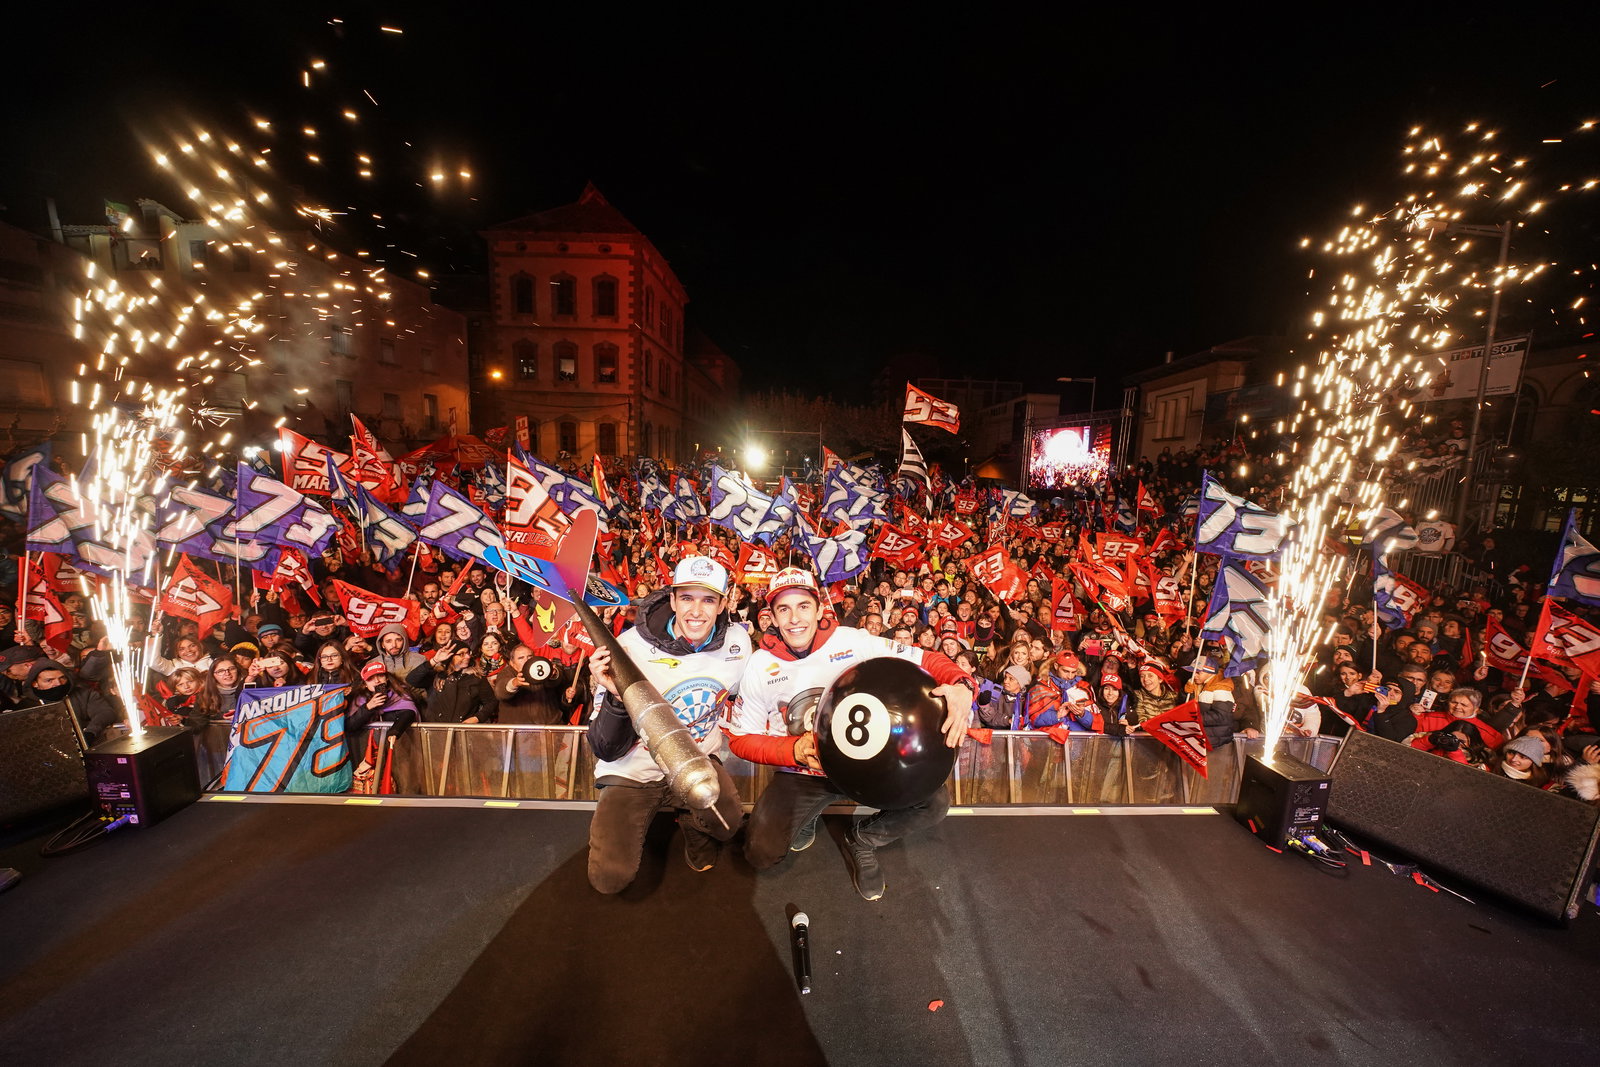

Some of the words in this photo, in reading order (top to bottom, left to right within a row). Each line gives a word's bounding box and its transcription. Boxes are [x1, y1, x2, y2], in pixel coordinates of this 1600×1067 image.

[1473, 343, 1518, 358] TISOT
[904, 389, 959, 425] 93
[236, 475, 342, 548] 73
[420, 493, 508, 560] 73
[775, 579, 790, 588] Red
[791, 577, 806, 585] Bull
[347, 597, 408, 625] 93
[677, 682, 709, 694] CHAMPION
[767, 675, 789, 686] REPSOL
[238, 684, 324, 724] MARQUEZ
[845, 704, 872, 747] 8
